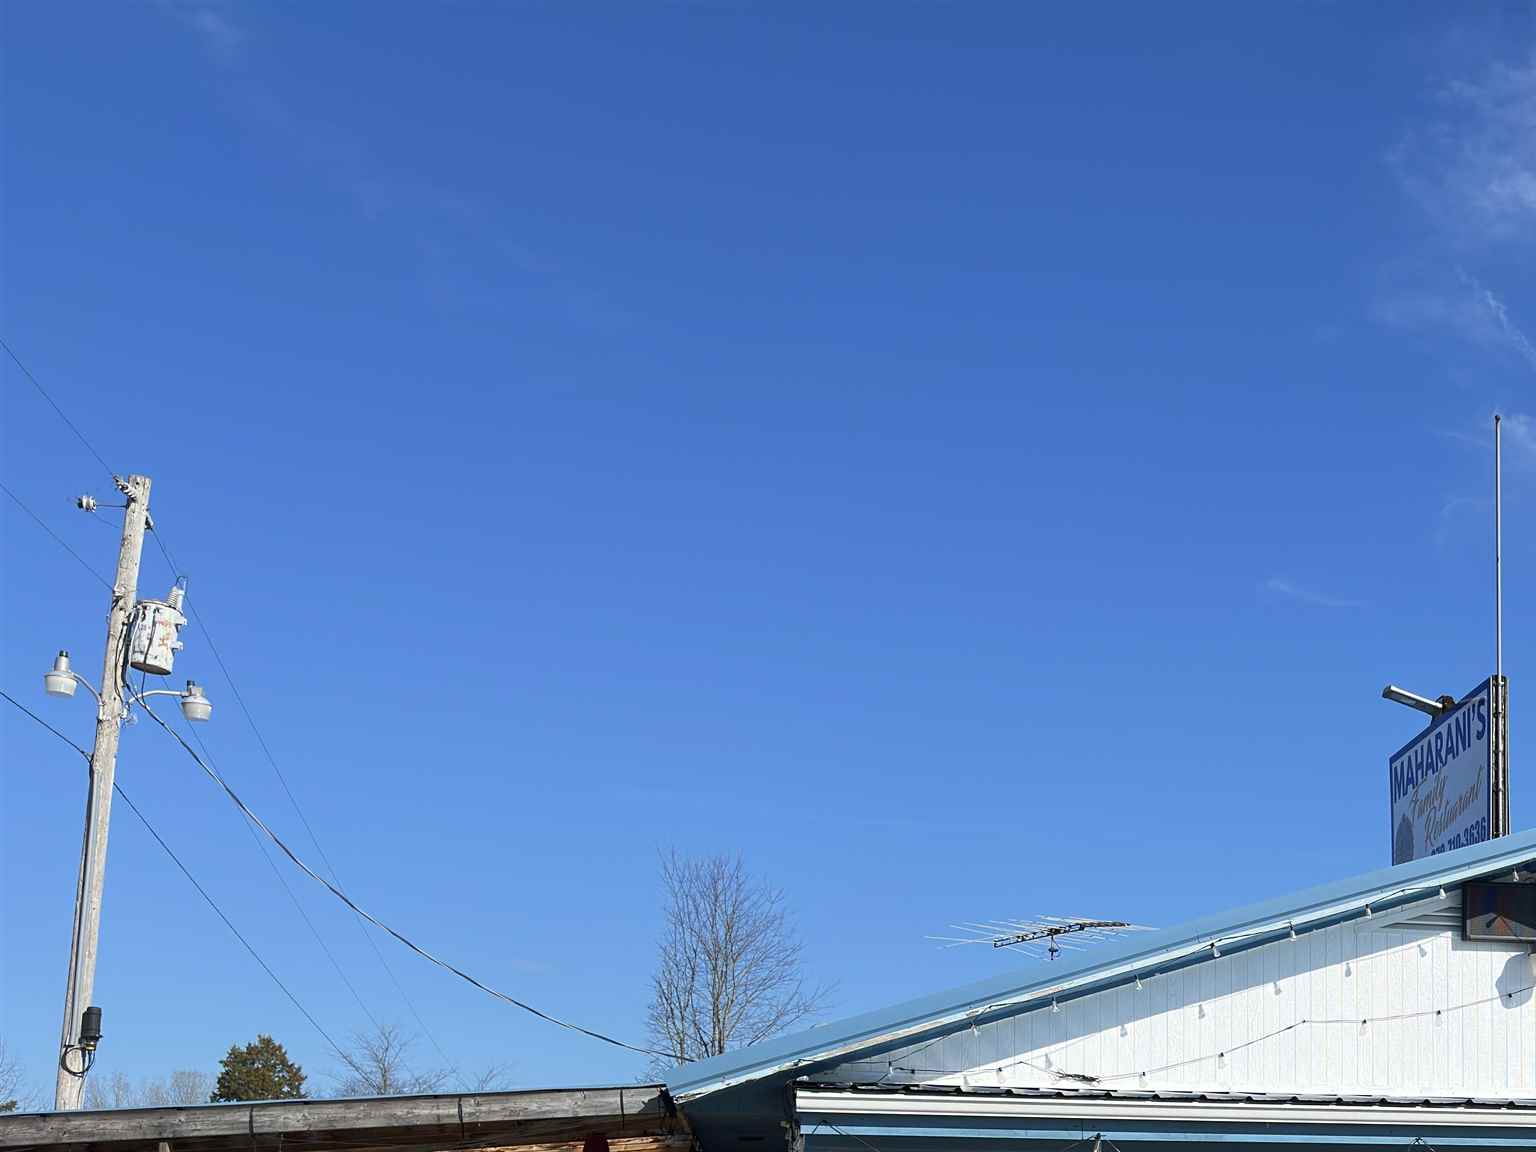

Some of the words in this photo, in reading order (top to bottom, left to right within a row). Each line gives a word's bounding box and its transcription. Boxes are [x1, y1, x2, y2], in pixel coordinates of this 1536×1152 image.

[1393, 701, 1486, 803] MAHARANI'S
[1410, 770, 1448, 823] Family
[1424, 764, 1484, 846] Restaurant
